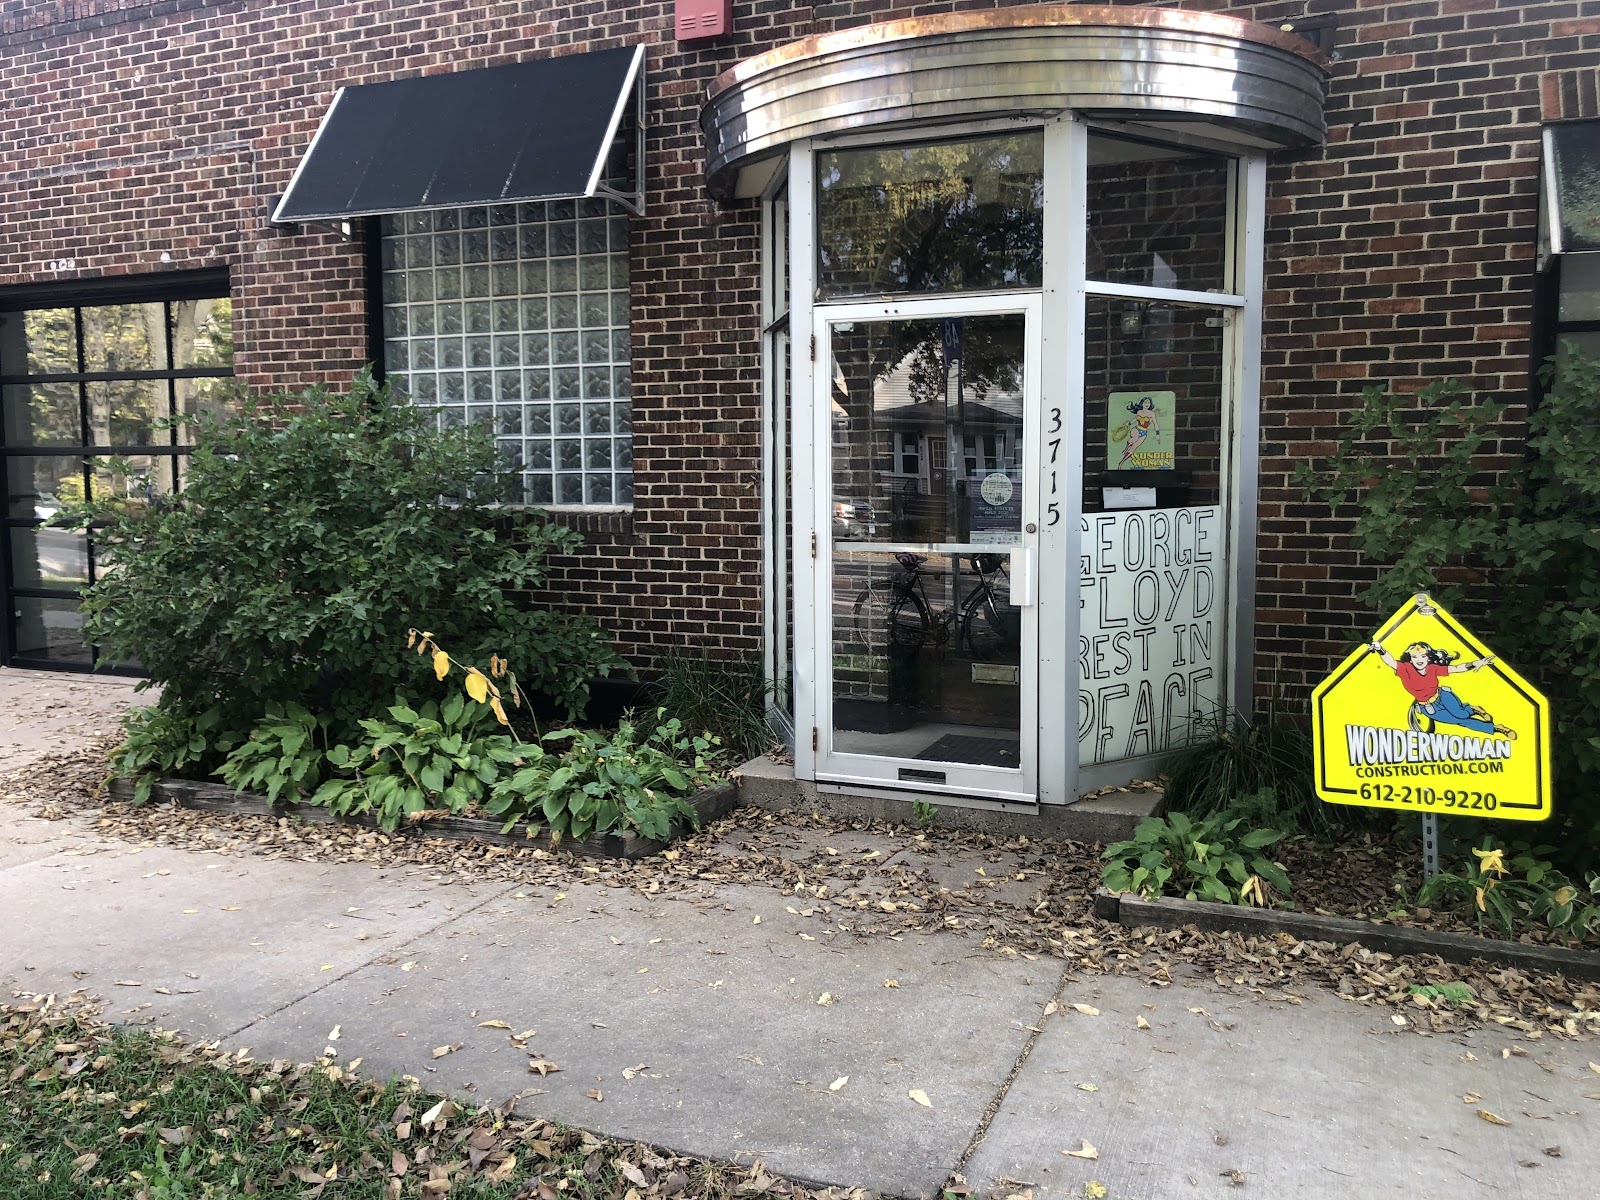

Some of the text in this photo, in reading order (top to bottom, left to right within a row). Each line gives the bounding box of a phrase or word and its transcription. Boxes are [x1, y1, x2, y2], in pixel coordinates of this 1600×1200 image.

[1047, 407, 1062, 526] 3715
[1131, 452, 1173, 460] WONDER
[1173, 621, 1212, 667] IN
[1345, 724, 1511, 766] WONDERWOMAN
[1355, 762, 1504, 779] CONSTRUCTION.COM
[1360, 783, 1497, 811] 612-210-9220
